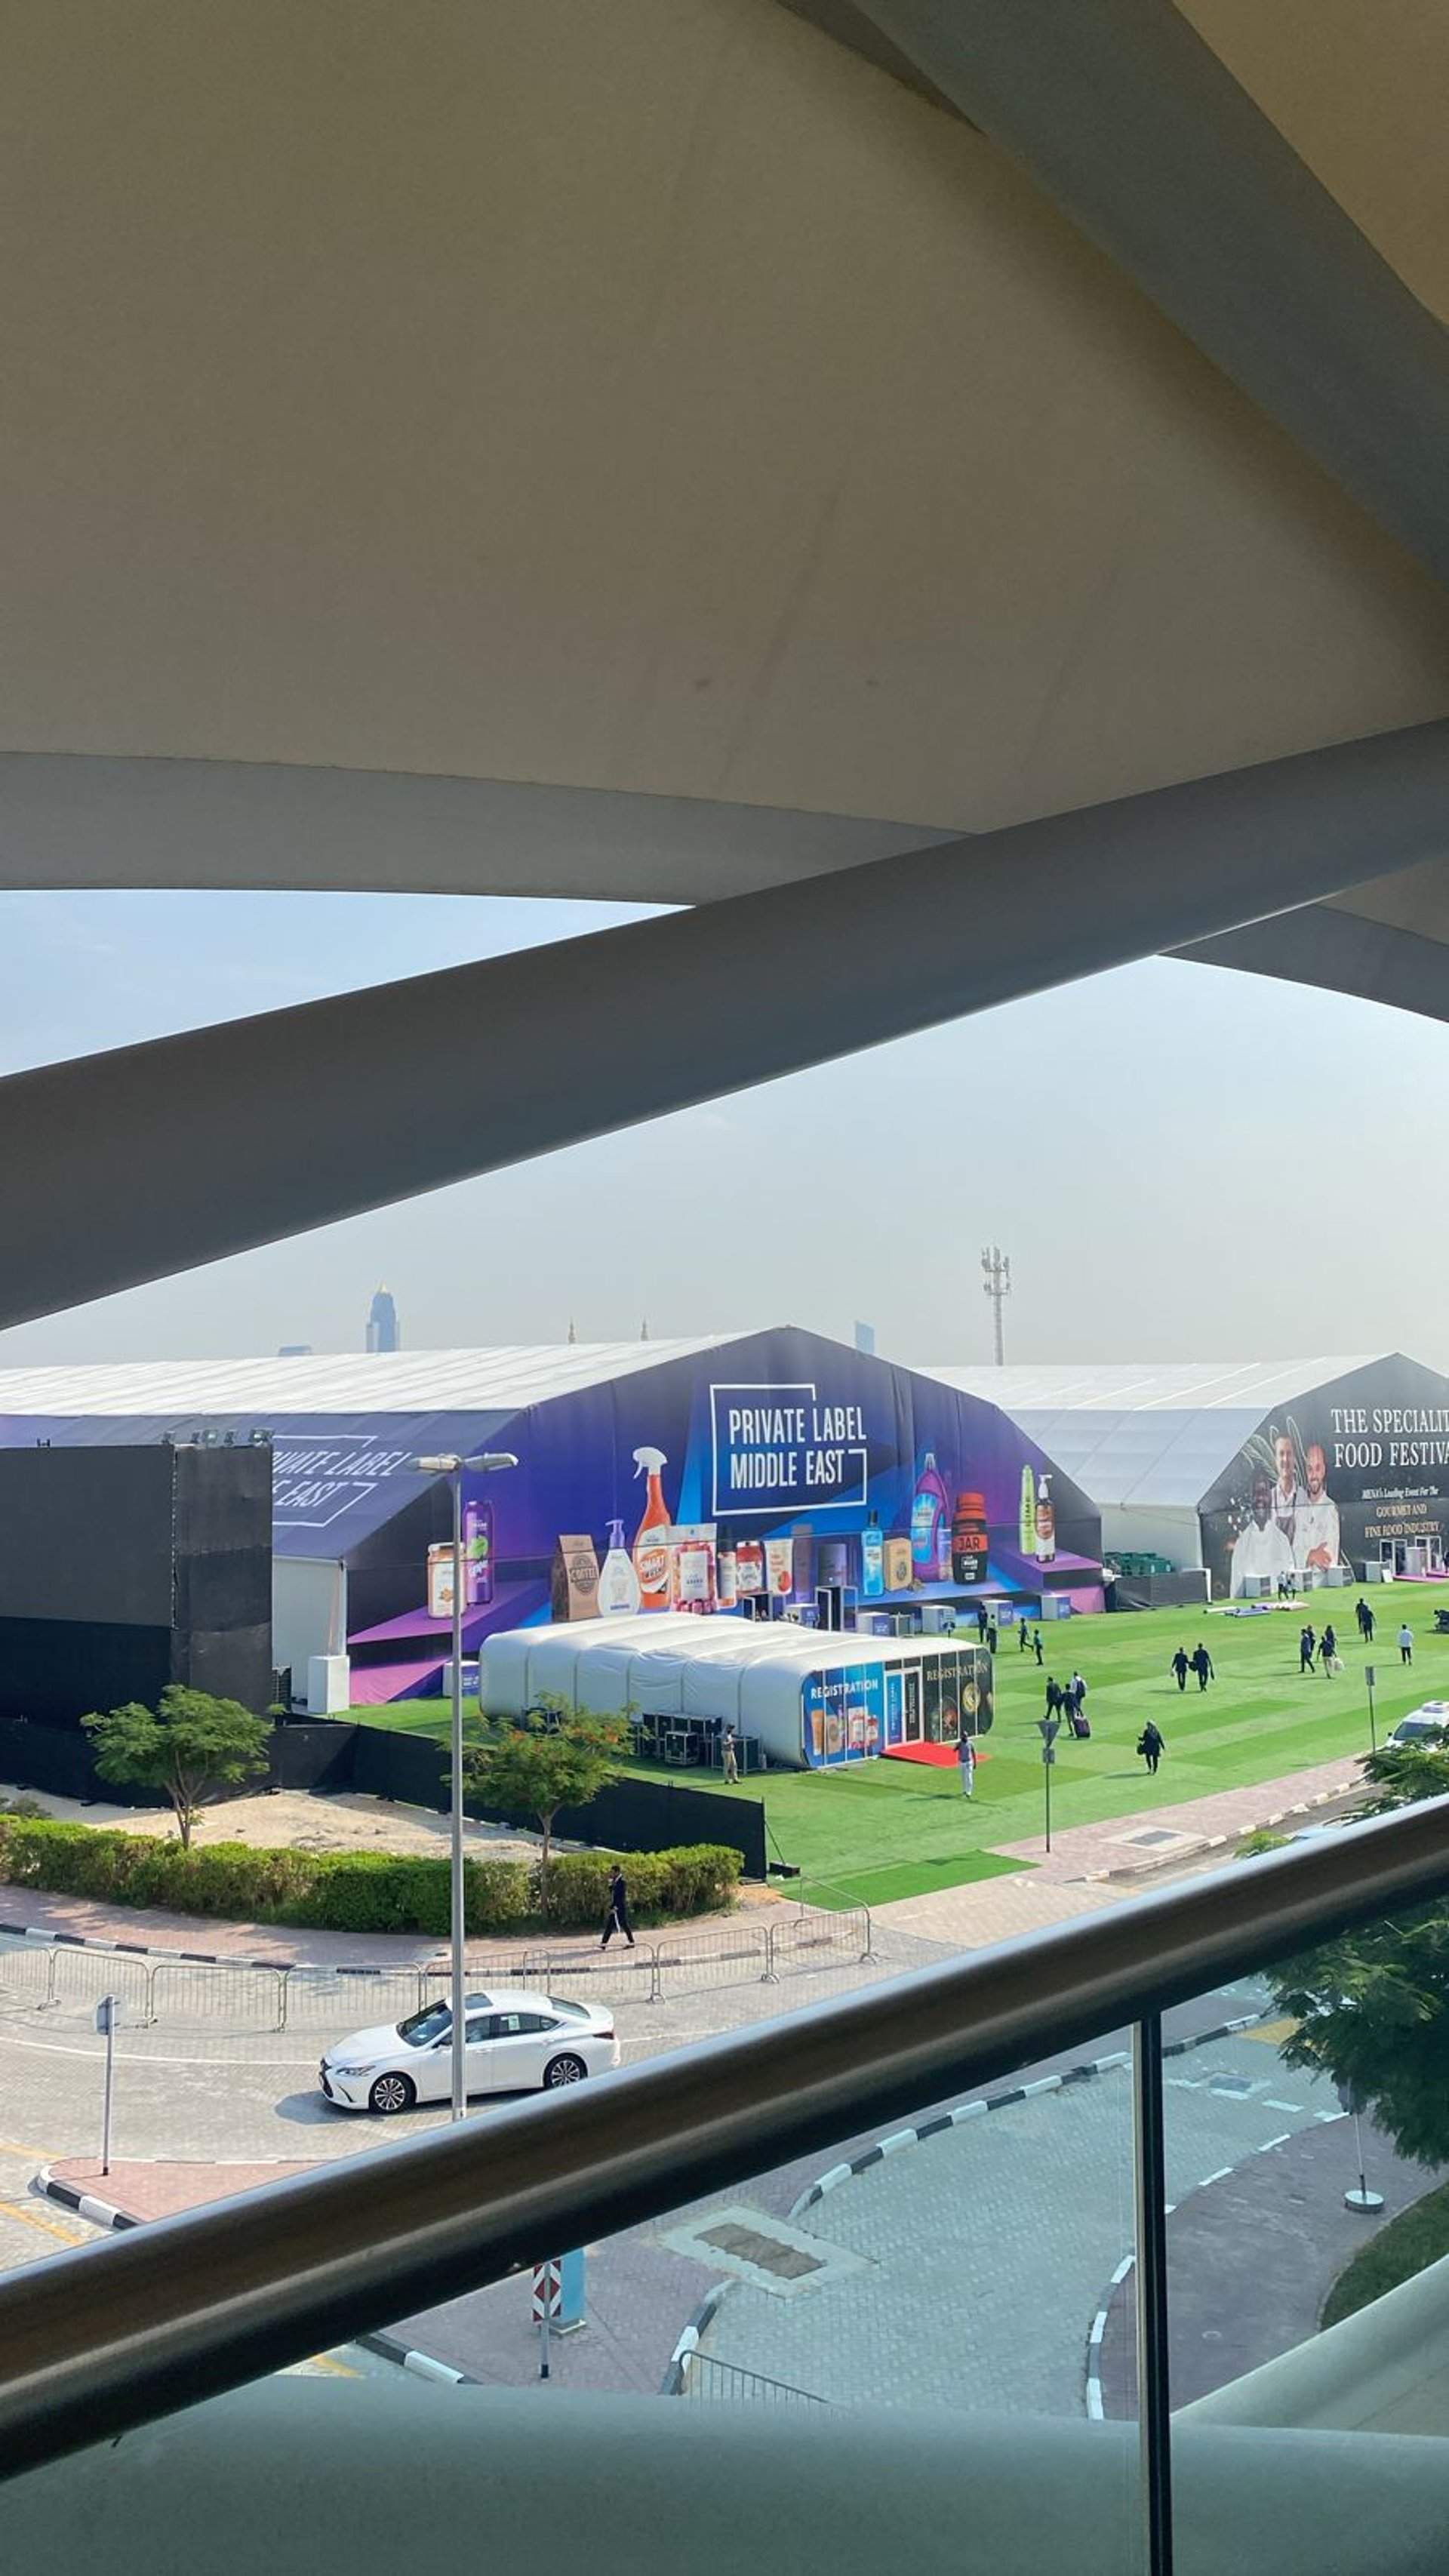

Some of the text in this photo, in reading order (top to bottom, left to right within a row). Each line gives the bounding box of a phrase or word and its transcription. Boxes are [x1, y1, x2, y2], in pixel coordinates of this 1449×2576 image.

[728, 1407, 867, 1445] PRIVATE LABEL
[1331, 1408, 1368, 1433] THE
[323, 1451, 413, 1476] LABEL
[1334, 1442, 1383, 1467] FOOD
[730, 1449, 844, 1489] MIDDLE EAST
[273, 1481, 350, 1507] EAST
[1411, 1503, 1428, 1516] AND
[958, 1537, 980, 1550] JAR
[927, 1662, 988, 1682] REGISTRATION
[811, 1679, 878, 1699] REGISTRATION
